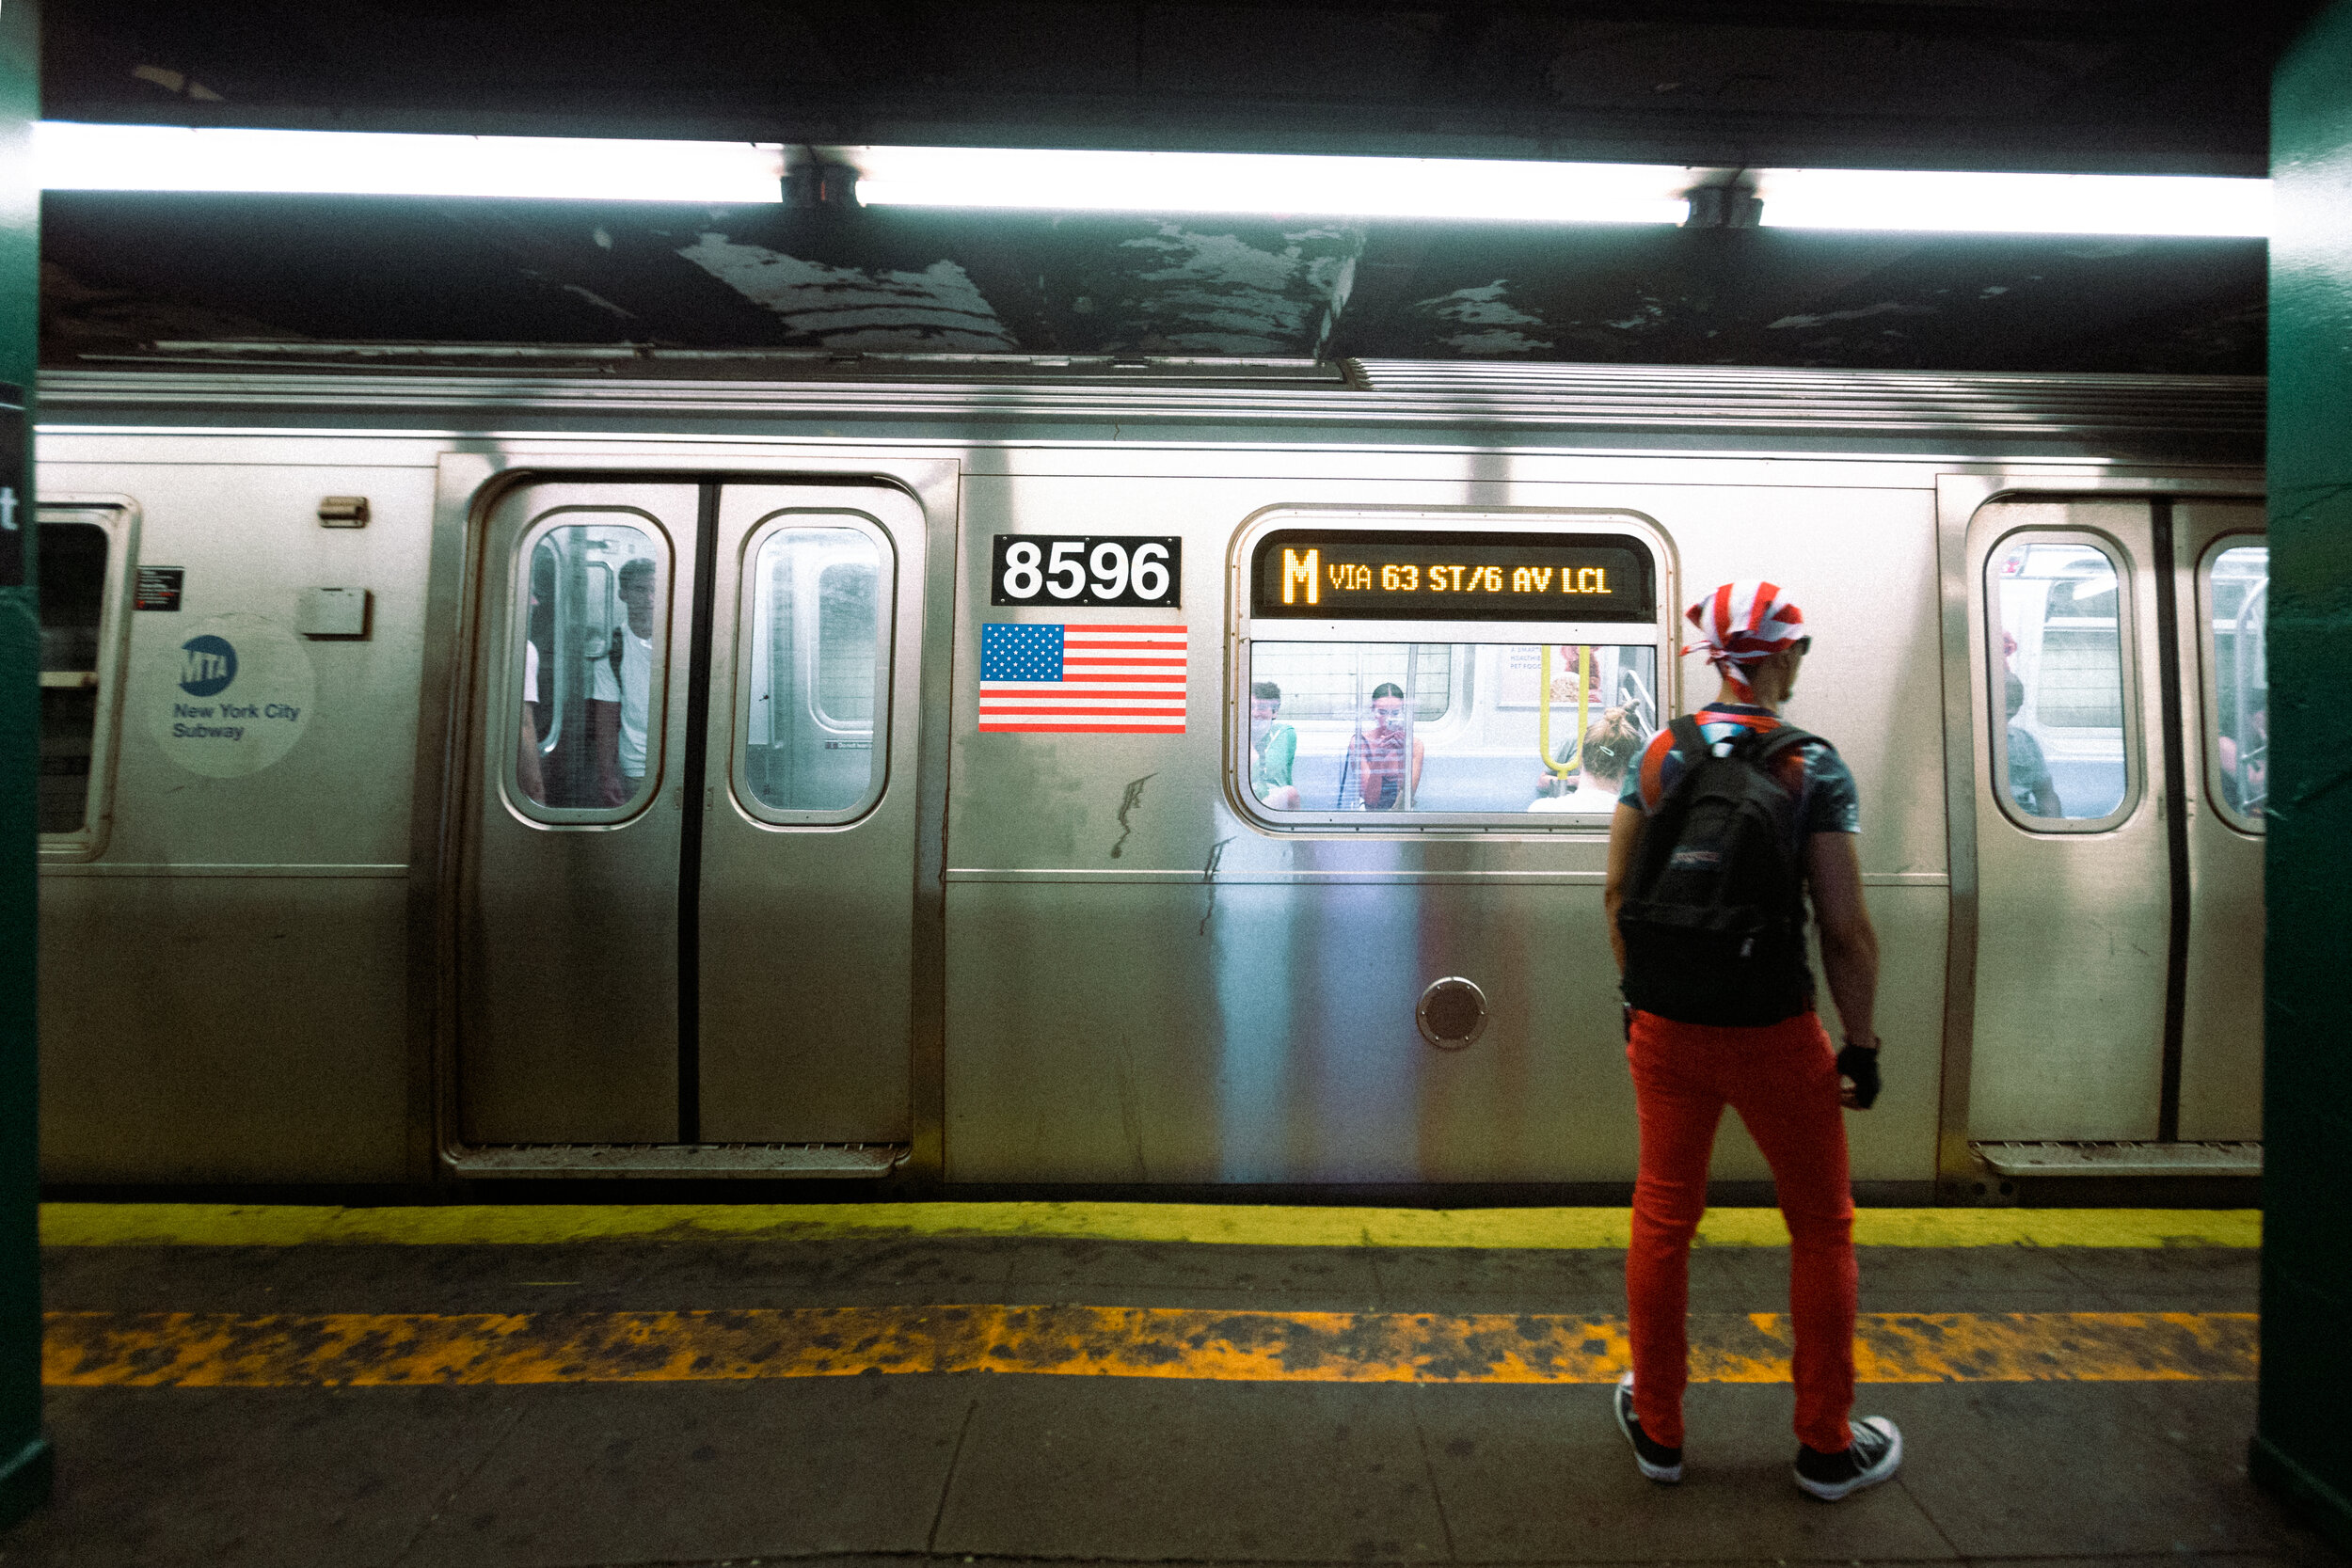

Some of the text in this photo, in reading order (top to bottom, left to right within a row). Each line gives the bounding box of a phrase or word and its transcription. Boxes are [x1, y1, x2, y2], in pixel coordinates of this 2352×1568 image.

[1003, 541, 1169, 600] 8596
[1284, 548, 1613, 605] M VIA 63 ST/6 AV LCL
[177, 646, 232, 686] MTA
[173, 703, 301, 722] New York City
[173, 722, 245, 741] Subway
